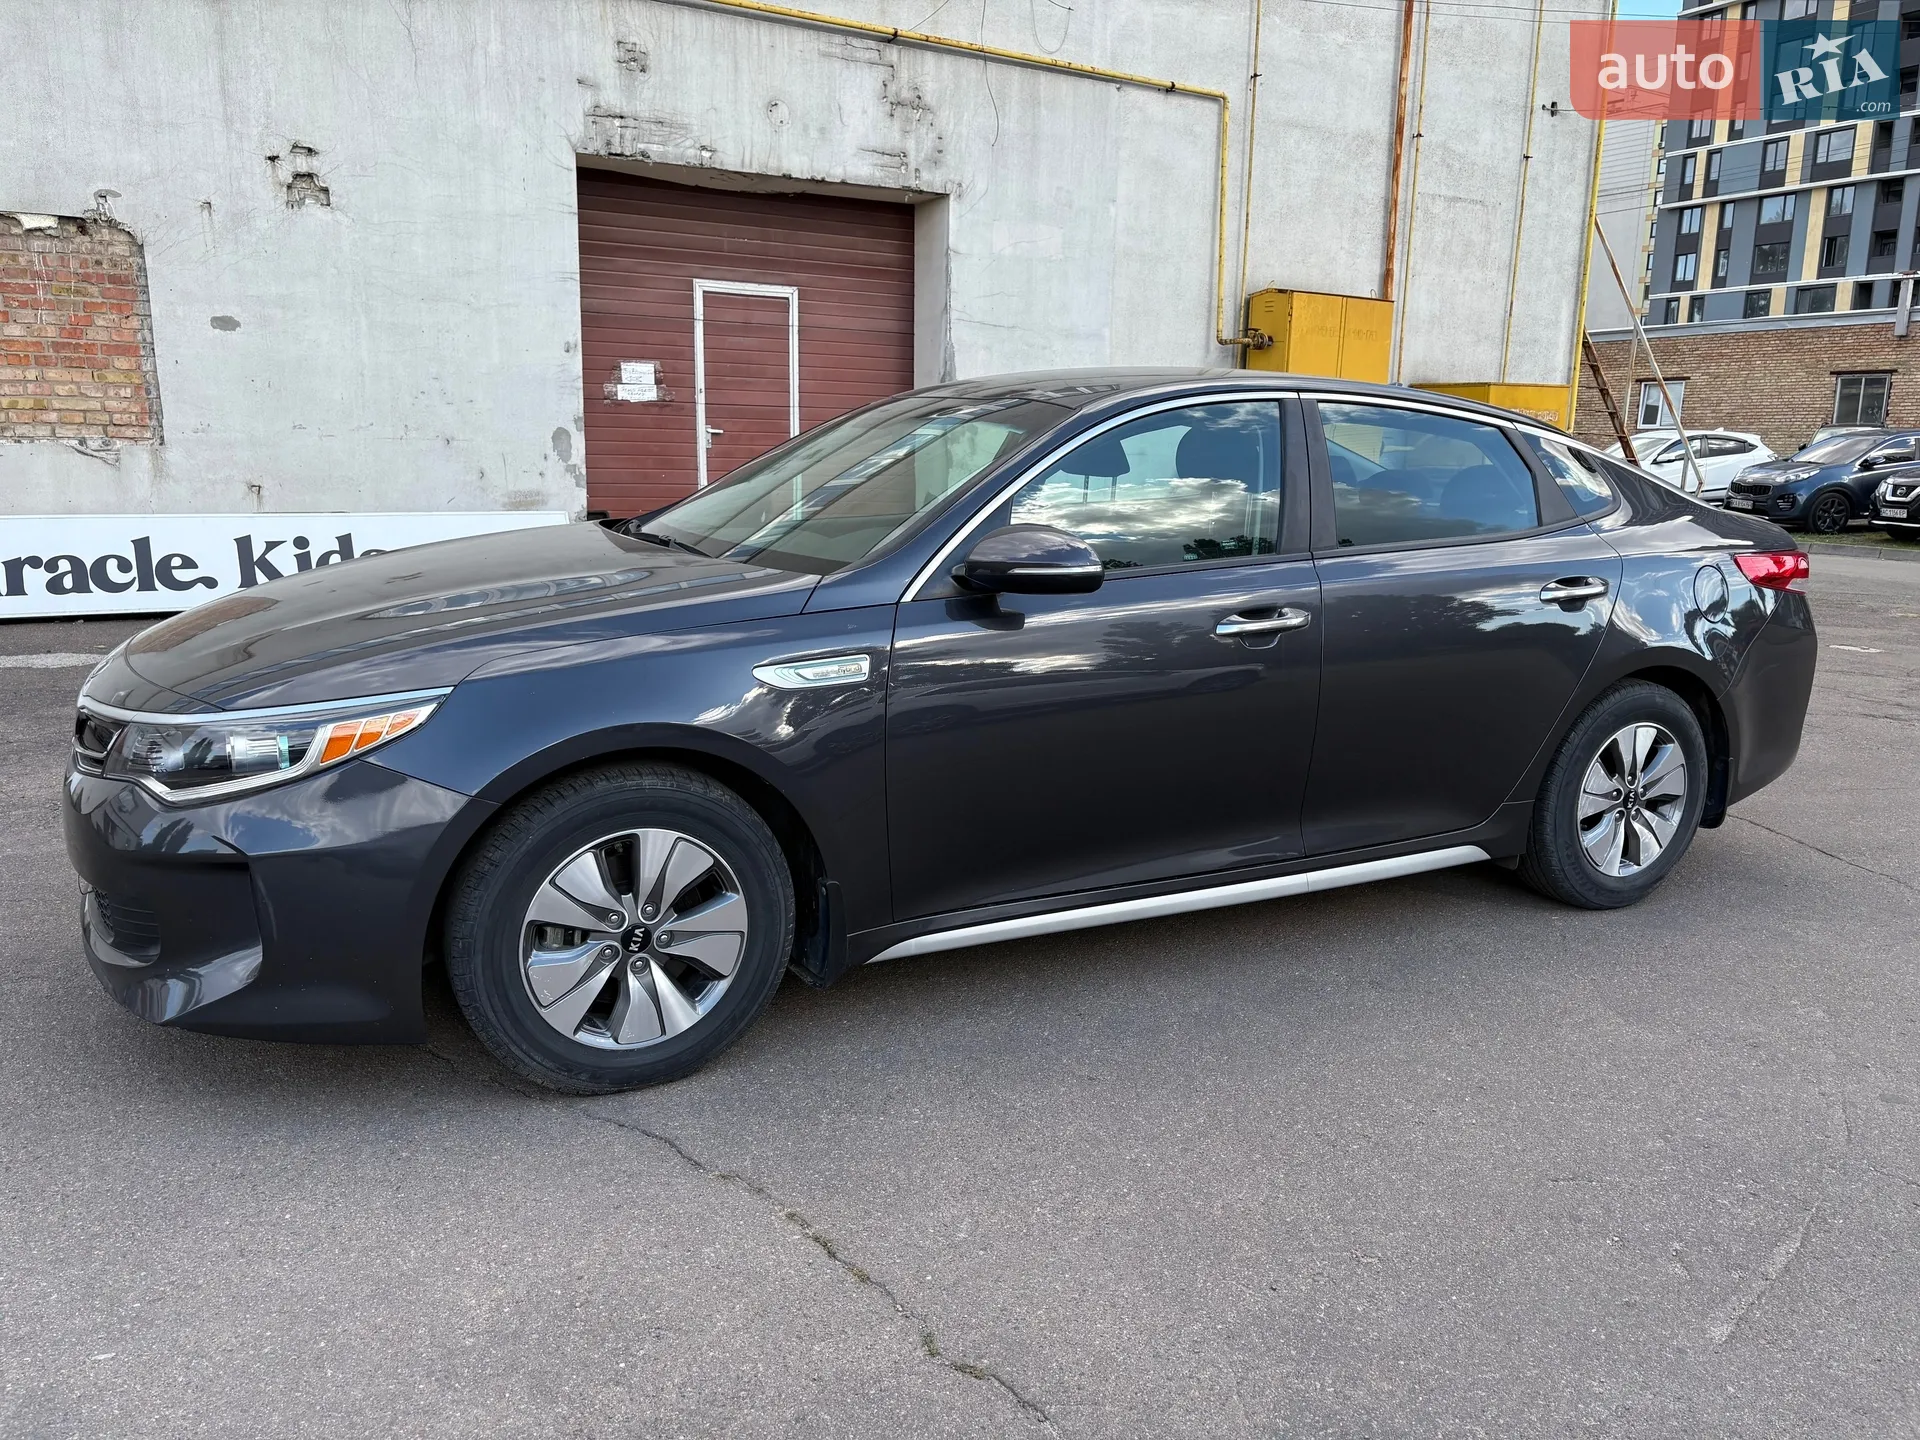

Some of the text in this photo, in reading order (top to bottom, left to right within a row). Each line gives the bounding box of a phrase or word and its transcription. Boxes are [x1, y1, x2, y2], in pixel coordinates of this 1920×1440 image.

[0, 532, 387, 597] racle Kid
[1627, 790, 1635, 809] KIA
[628, 927, 645, 951] KIA
